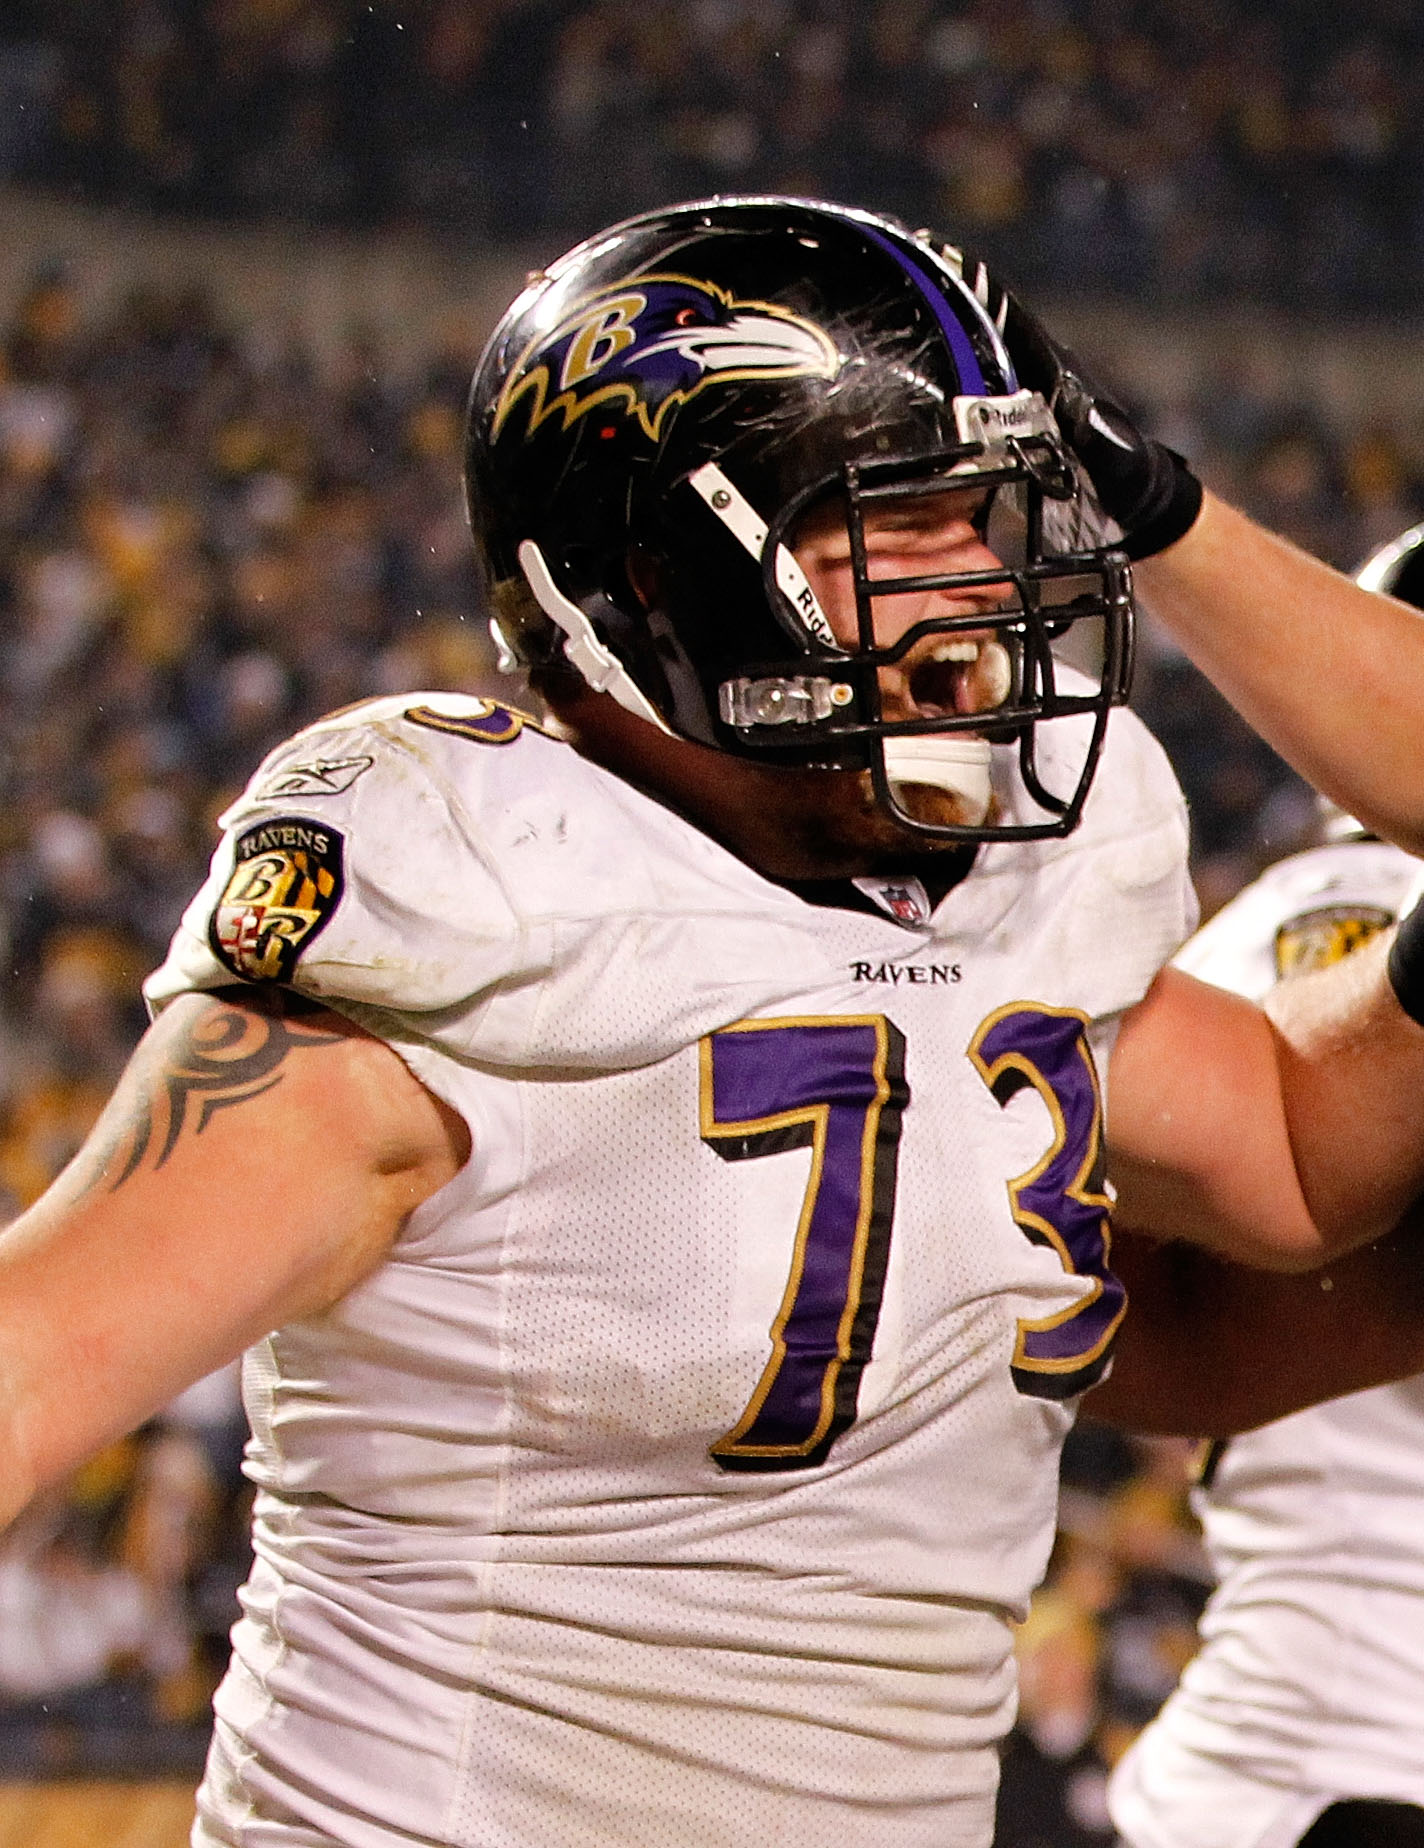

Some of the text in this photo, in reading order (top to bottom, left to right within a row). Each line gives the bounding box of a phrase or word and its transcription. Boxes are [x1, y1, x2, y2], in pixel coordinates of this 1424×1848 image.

[240, 827, 329, 858] RAVENS
[850, 961, 962, 986] RAVENS
[700, 1000, 1129, 1475] 73
